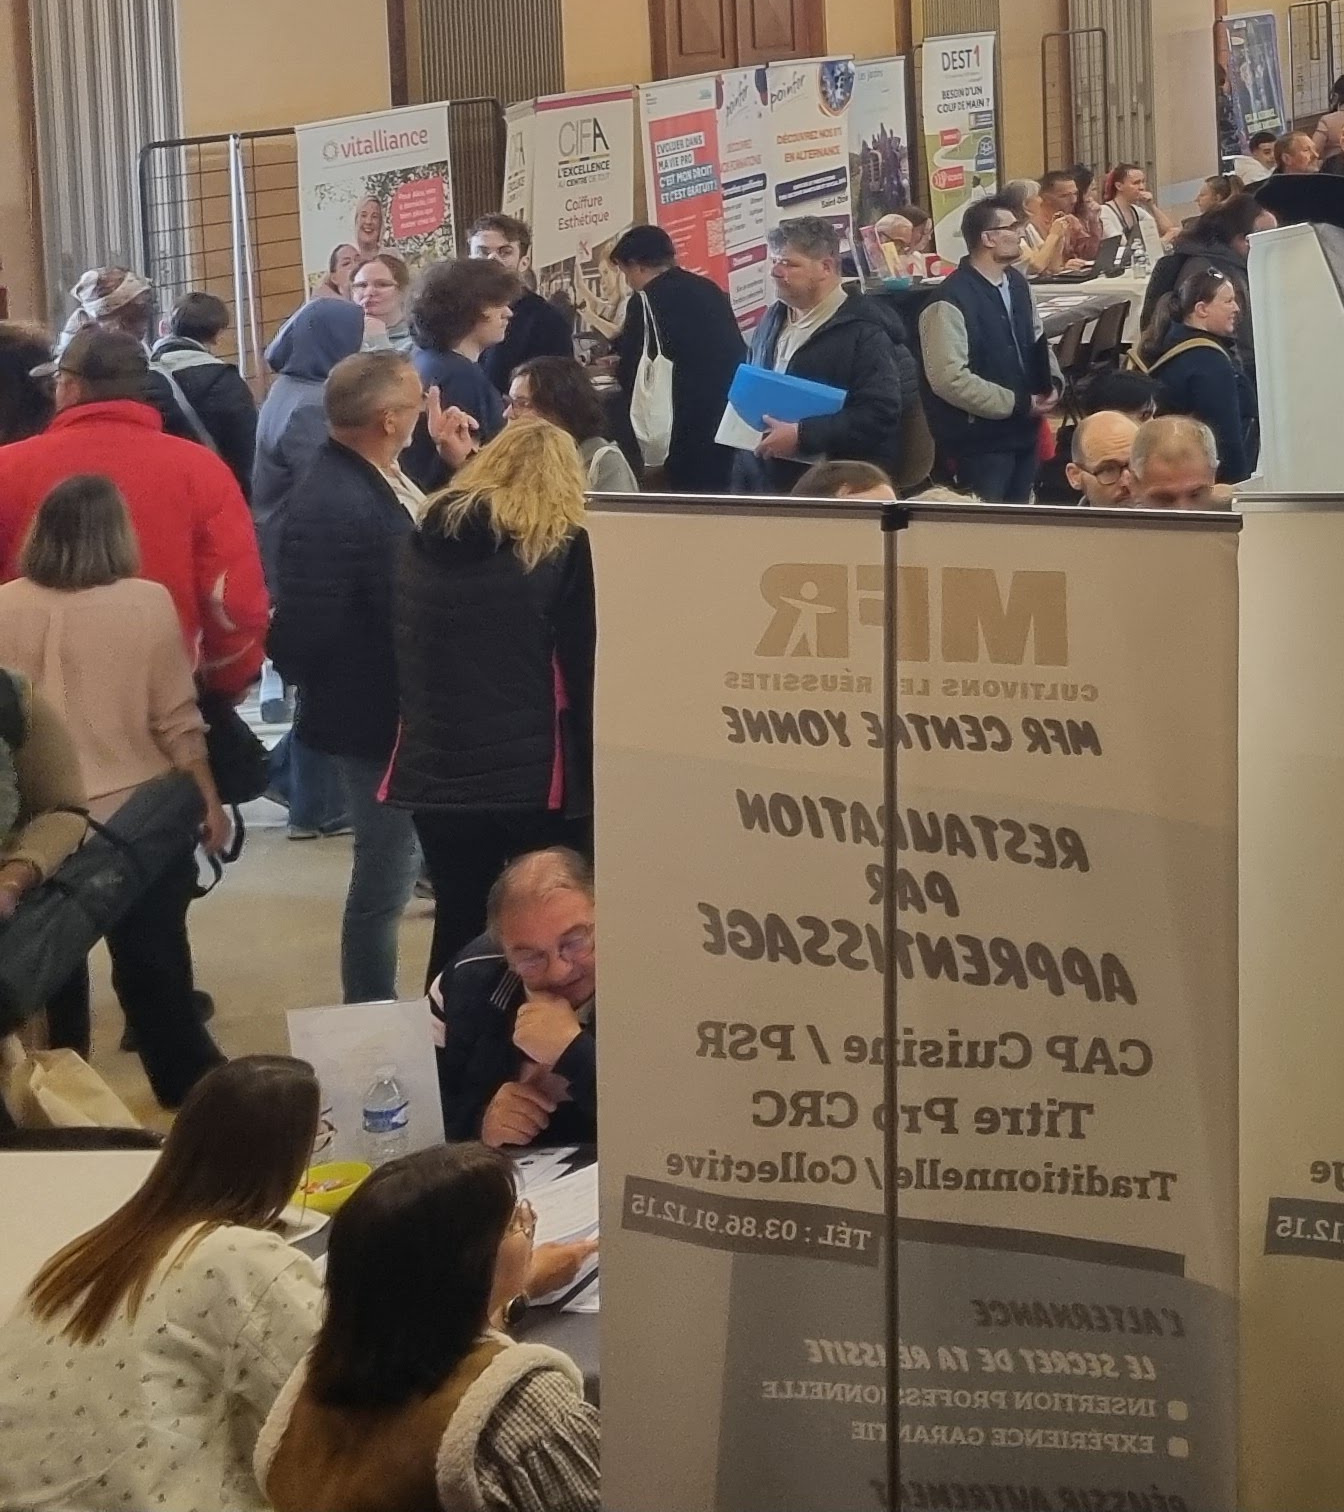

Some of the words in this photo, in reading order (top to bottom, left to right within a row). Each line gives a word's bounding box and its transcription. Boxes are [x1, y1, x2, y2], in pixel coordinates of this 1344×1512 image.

[340, 127, 428, 160] vitalliance
[558, 117, 610, 157] CIFA
[565, 194, 603, 212] Coiffure
[558, 210, 610, 231] Esthétique
